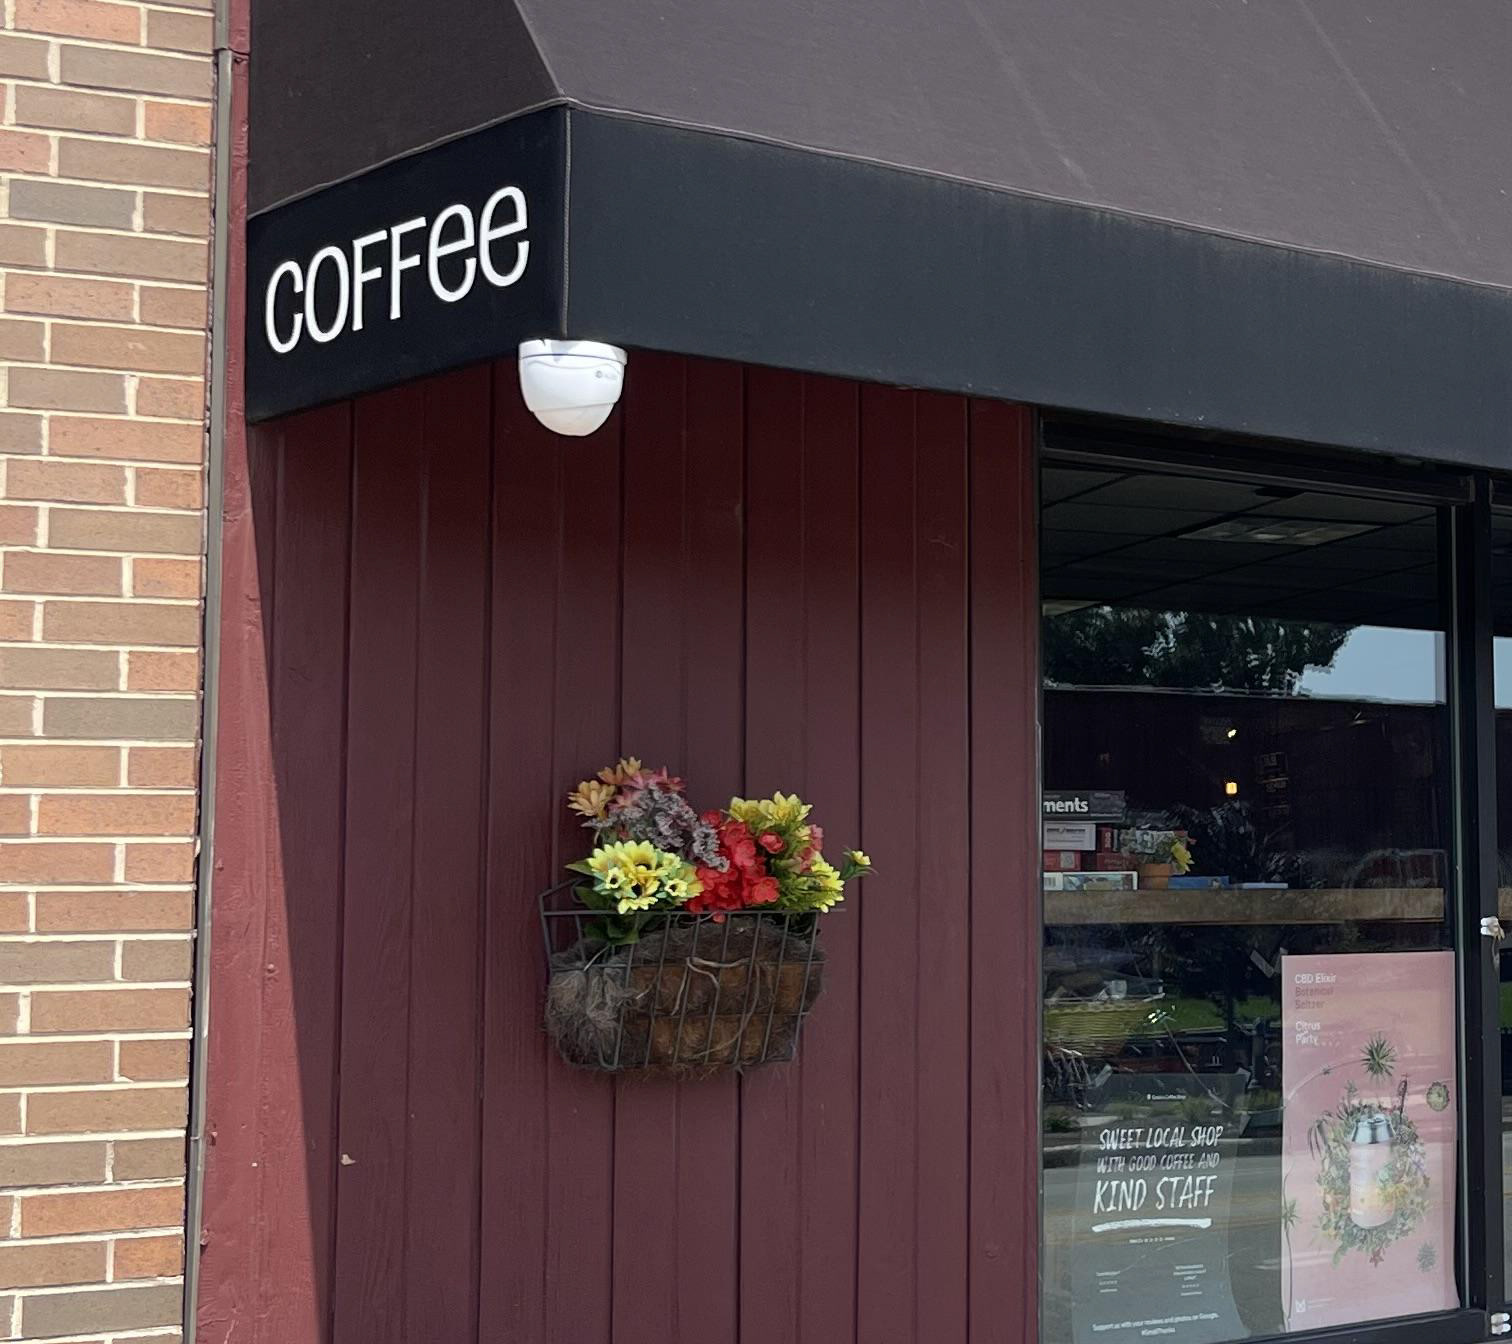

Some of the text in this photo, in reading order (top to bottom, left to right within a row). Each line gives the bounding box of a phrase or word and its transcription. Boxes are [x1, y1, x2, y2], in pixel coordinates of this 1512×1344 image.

[1294, 972, 1336, 984] CBD Elixir
[1295, 1021, 1321, 1031] Citrus
[1295, 1032, 1319, 1046] Party
[1100, 1125, 1224, 1151] SWEET LOCAL SHOP
[1097, 1152, 1220, 1174] WITH GOOD COFFEE AND
[1093, 1175, 1218, 1214] KIND STAFF
